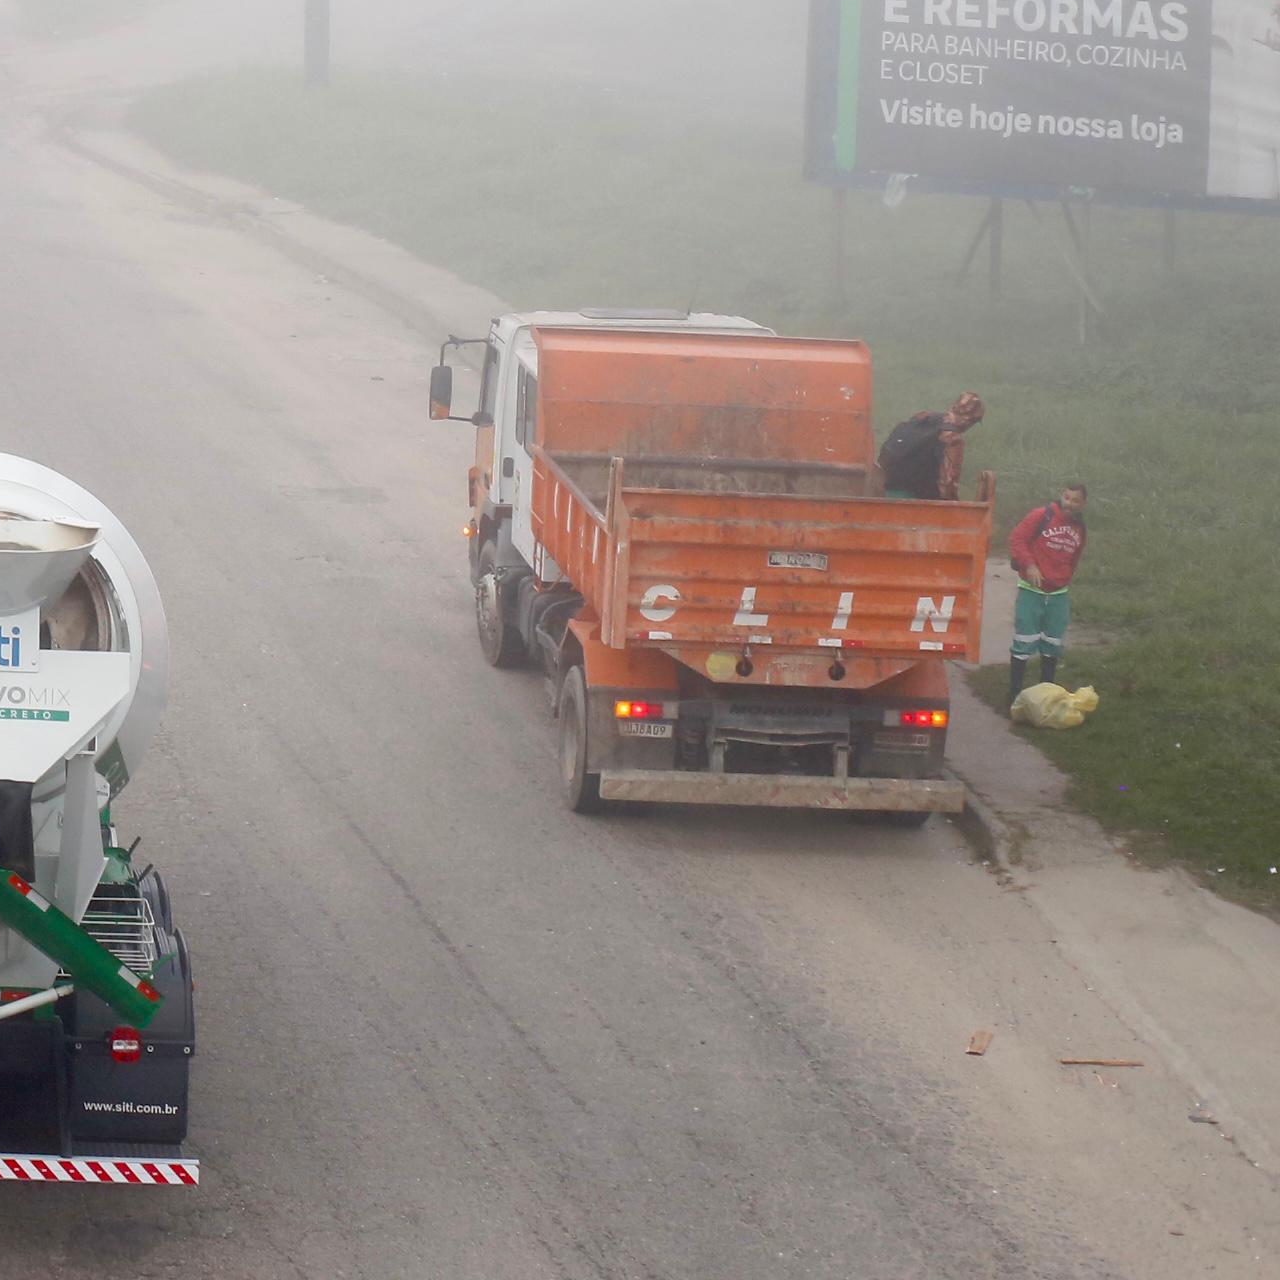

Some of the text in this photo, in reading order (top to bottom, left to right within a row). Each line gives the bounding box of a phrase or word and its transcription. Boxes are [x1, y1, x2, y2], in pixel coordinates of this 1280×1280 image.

[881, 31, 1187, 71] PARA BANHEIRO, COZINHA
[880, 59, 989, 86] E CLOSET
[879, 97, 1184, 149] Visite hoje nossa loja
[83, 1101, 179, 1115] www.siti.com.br
